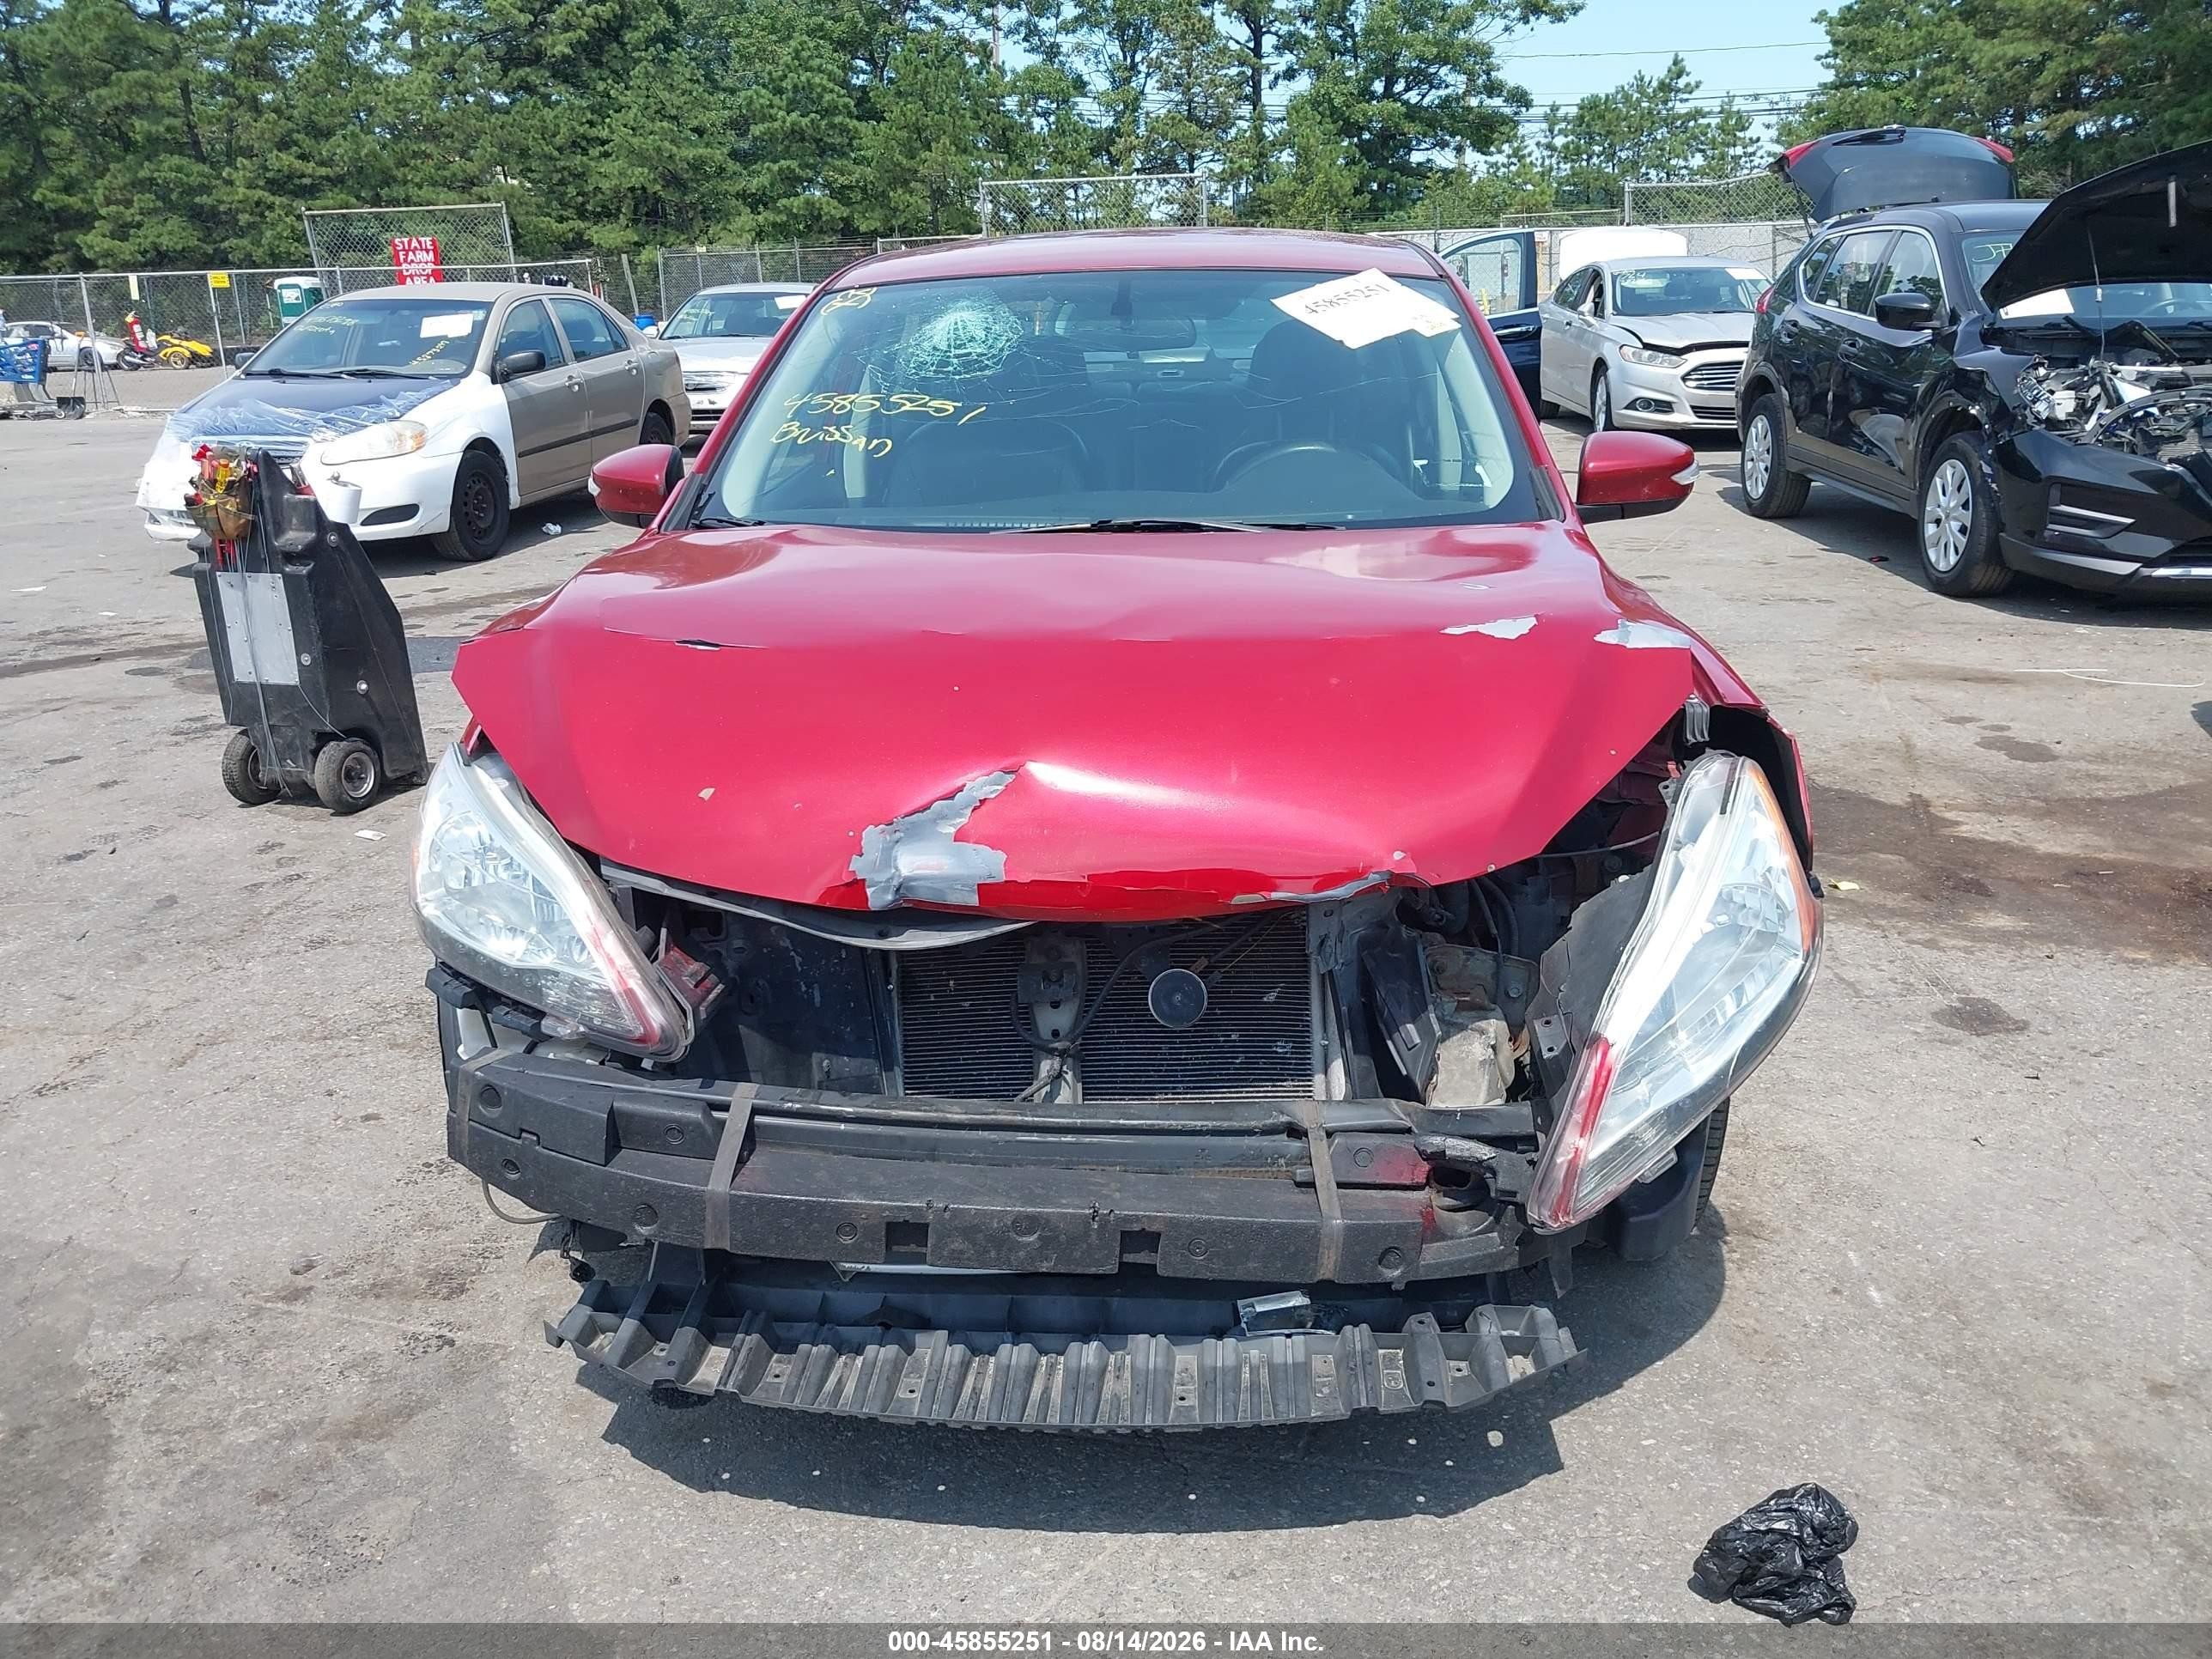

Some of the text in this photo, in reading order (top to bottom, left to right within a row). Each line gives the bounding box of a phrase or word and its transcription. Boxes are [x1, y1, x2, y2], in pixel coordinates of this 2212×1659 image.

[394, 237, 434, 251] STATE
[398, 250, 435, 264] FARM
[401, 263, 435, 276] DROP
[1304, 283, 1391, 315] 45855251
